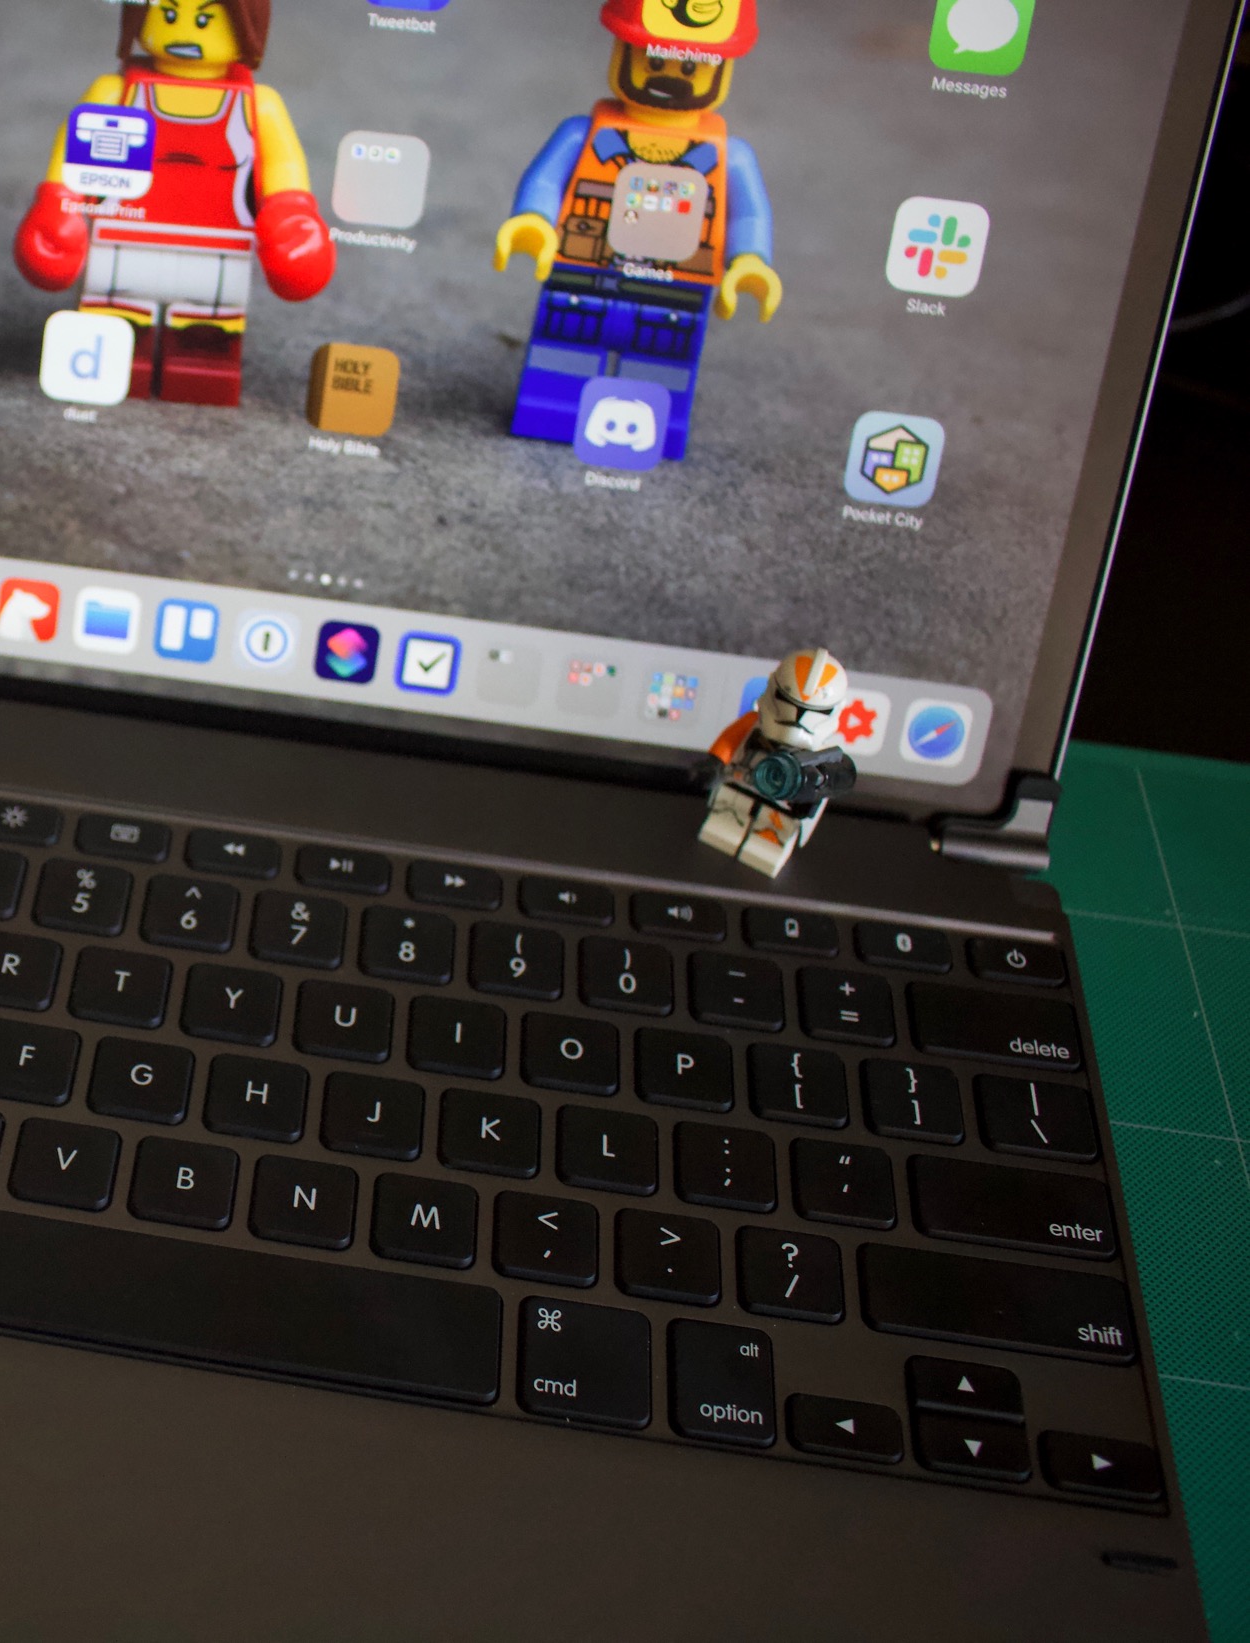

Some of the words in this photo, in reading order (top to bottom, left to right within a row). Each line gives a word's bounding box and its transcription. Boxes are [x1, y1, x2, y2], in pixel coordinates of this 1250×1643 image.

[367, 12, 437, 33] Tweetbot
[646, 43, 723, 67] Mailchimp
[931, 76, 1008, 99] Messages
[80, 172, 131, 189] EPSON
[329, 227, 418, 254] Productivity
[622, 262, 674, 283] Games
[906, 297, 947, 317] Slack
[334, 357, 372, 376] HOLY
[331, 374, 372, 395] BIBLE
[308, 435, 342, 456] Holy
[343, 439, 381, 458] Bible
[584, 470, 641, 492] Discord
[842, 504, 892, 525] Pocket
[895, 511, 924, 532] City
[76, 868, 97, 889] %
[71, 892, 91, 913] 5
[290, 902, 310, 921] &
[180, 910, 198, 930] 6
[291, 924, 308, 945] 7
[398, 940, 416, 963] 8
[1, 953, 21, 976] R
[509, 957, 527, 978] 9
[114, 970, 131, 992] T
[618, 972, 637, 994] 0
[839, 982, 856, 996] +
[225, 987, 244, 1009] Y
[334, 1005, 357, 1028] U
[840, 1009, 860, 1023] =
[455, 1022, 462, 1044] I
[18, 1044, 36, 1067] F
[560, 1038, 584, 1060] O
[1010, 1038, 1070, 1059] delete
[130, 1063, 153, 1086] G
[676, 1053, 695, 1075] P
[245, 1080, 269, 1105] H
[366, 1101, 382, 1123] J
[480, 1116, 501, 1141] K
[602, 1134, 616, 1158] L
[56, 1146, 78, 1171] V
[176, 1166, 195, 1190] B
[293, 1185, 317, 1211] N
[410, 1203, 441, 1230] M
[537, 1211, 559, 1231] <
[660, 1227, 682, 1246] >
[1050, 1222, 1103, 1242] enter
[781, 1242, 799, 1269] ?
[1078, 1324, 1122, 1346] shift
[740, 1343, 759, 1358] alt
[534, 1374, 577, 1397] cmd
[699, 1402, 763, 1427] option
